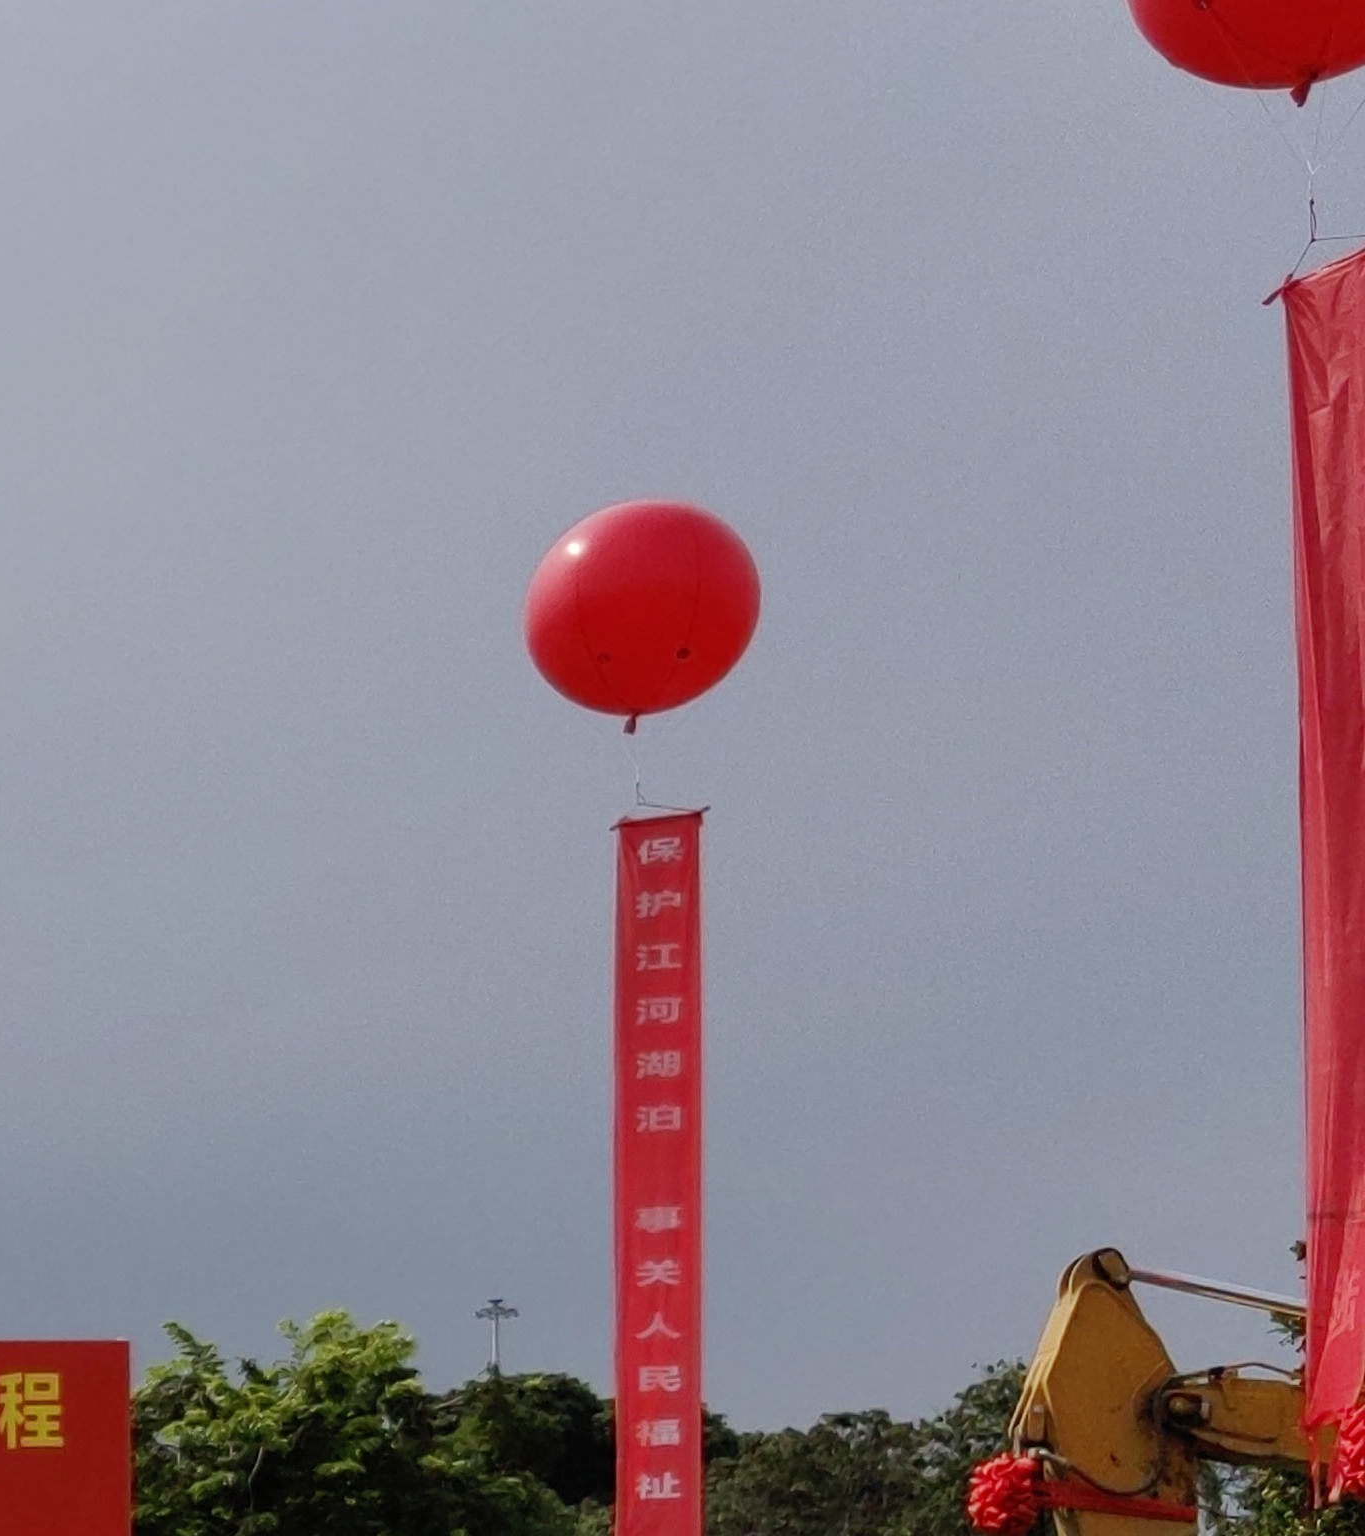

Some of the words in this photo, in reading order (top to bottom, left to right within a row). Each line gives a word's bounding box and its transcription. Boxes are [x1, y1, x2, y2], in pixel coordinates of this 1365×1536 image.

[635, 836, 683, 1133] 保护江河湖泊
[635, 1206, 682, 1500] 事关人民福祉
